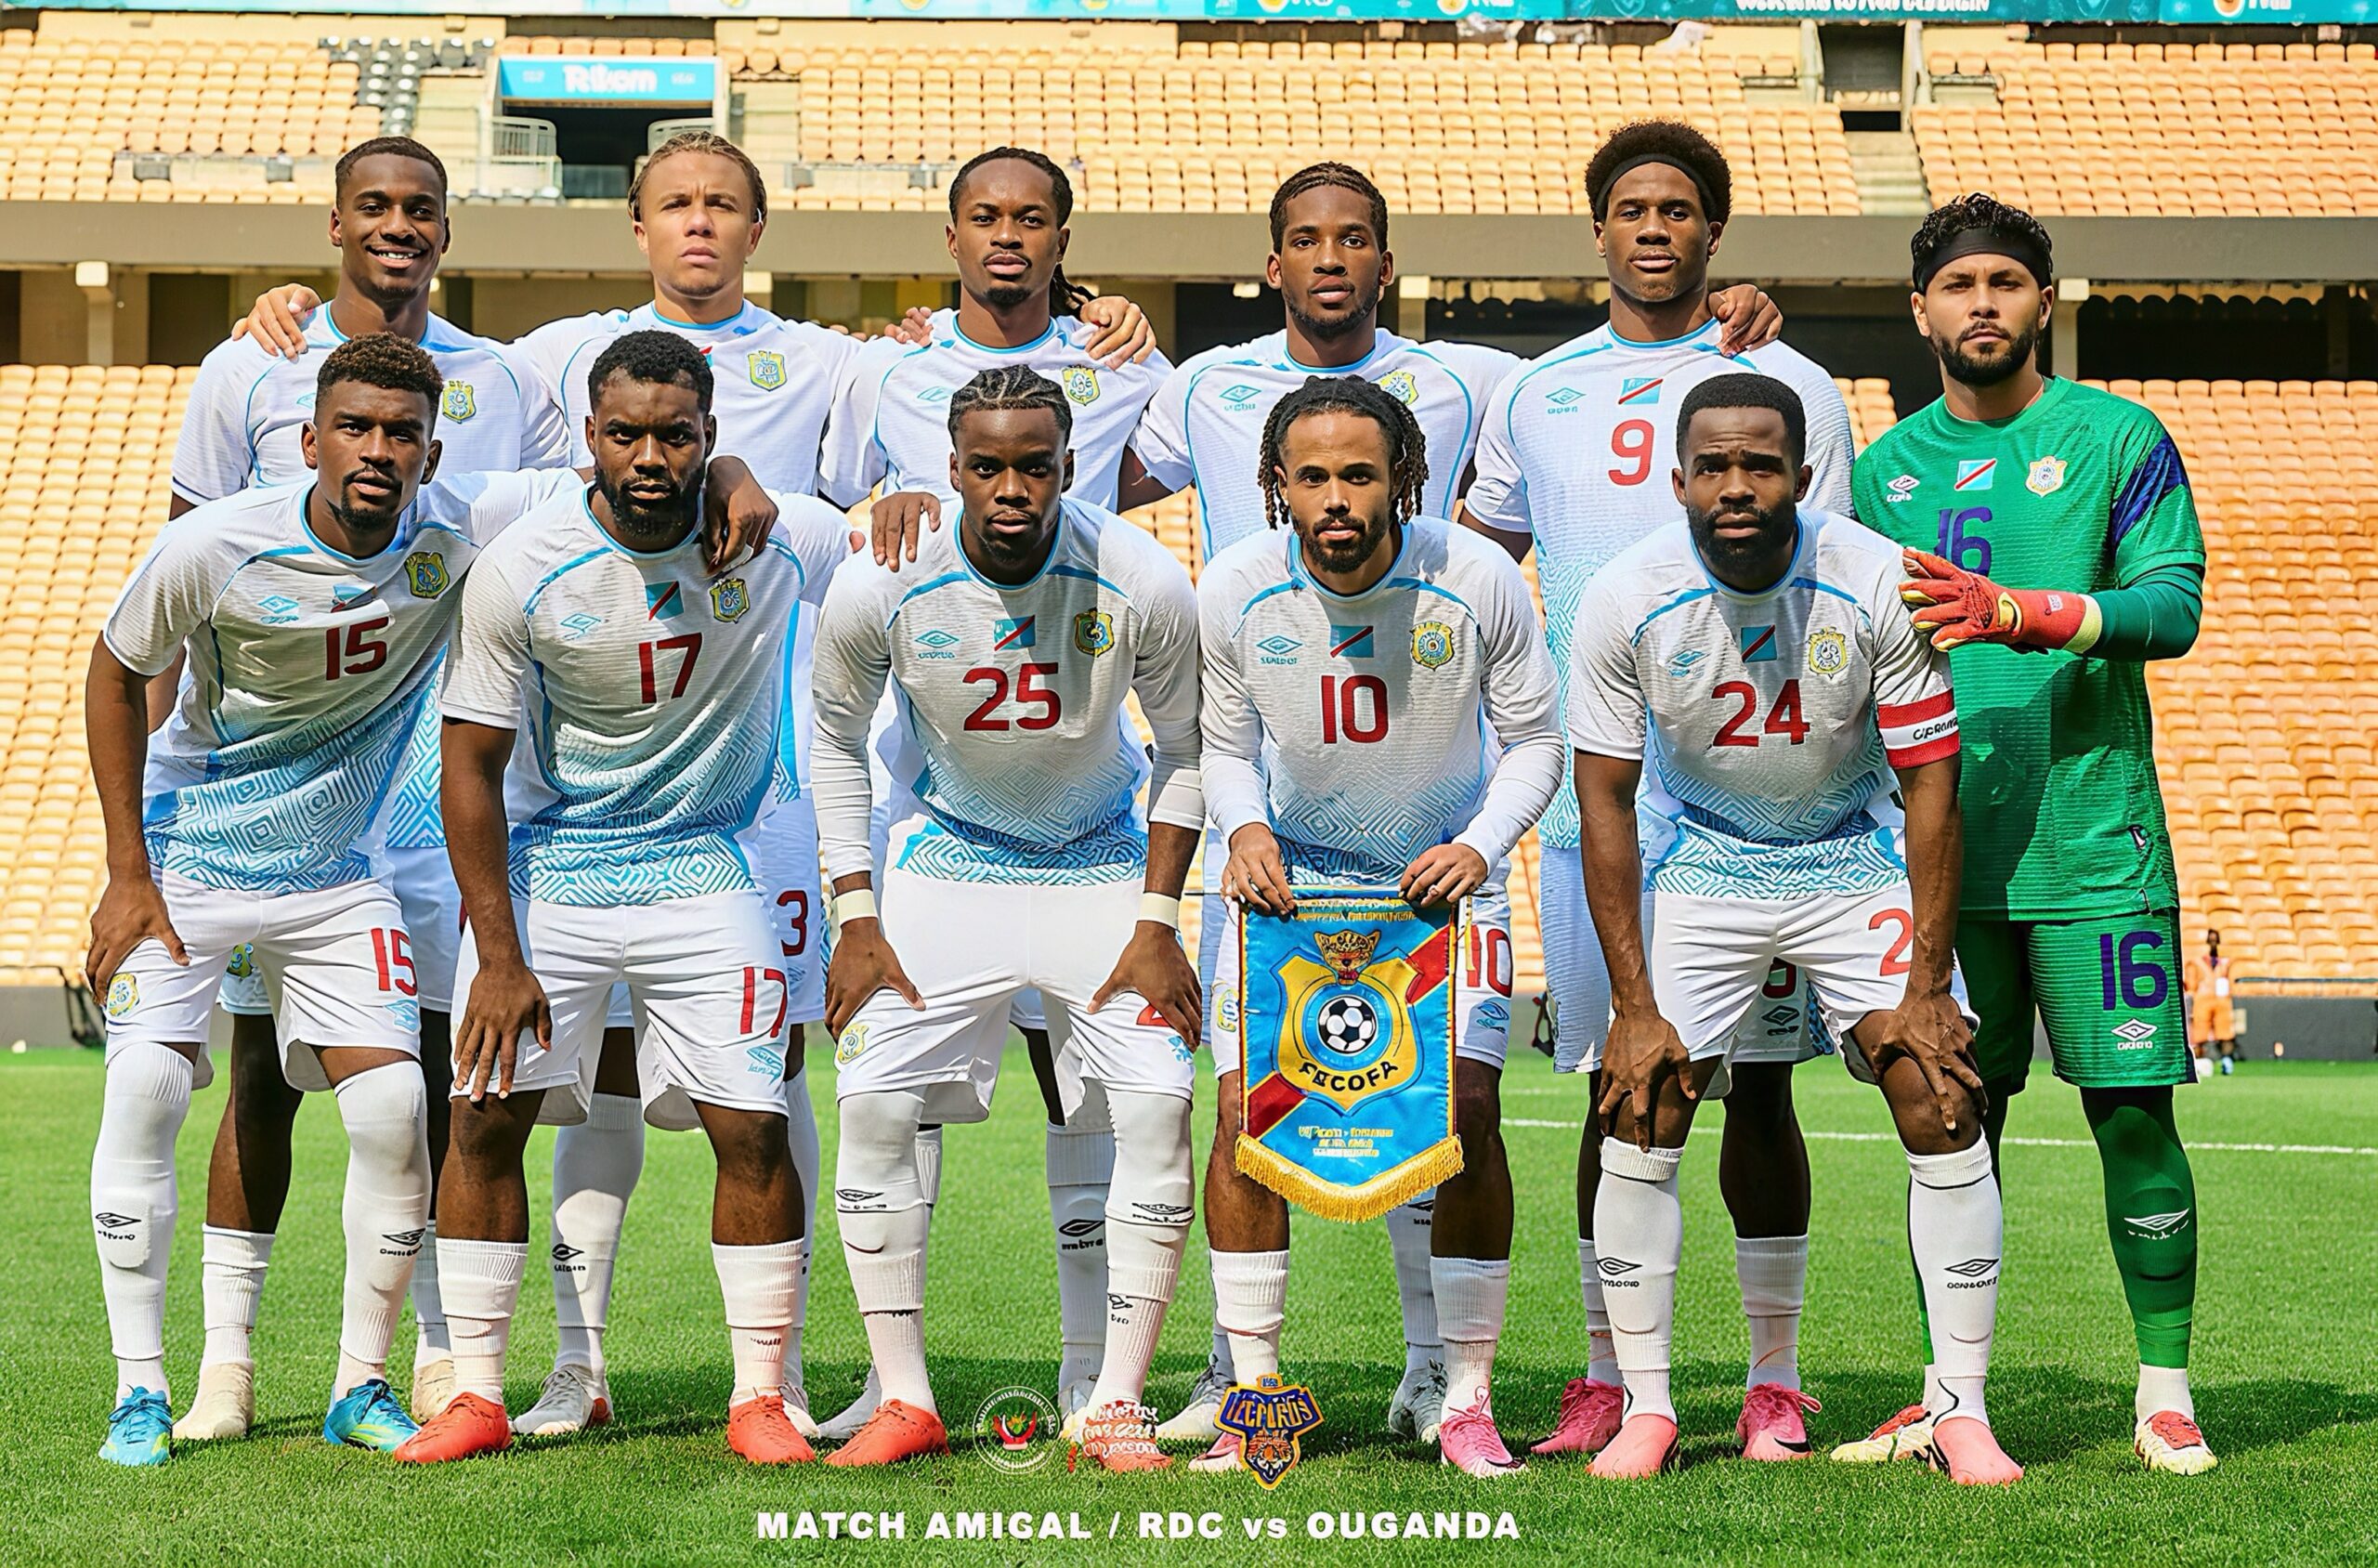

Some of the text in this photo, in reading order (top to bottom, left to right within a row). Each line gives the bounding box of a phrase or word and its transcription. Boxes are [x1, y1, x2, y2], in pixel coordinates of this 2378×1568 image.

[1608, 420, 1654, 486] 9
[1934, 506, 1993, 577] 16
[326, 617, 390, 681] 15
[639, 633, 702, 704] 17
[962, 662, 1062, 731] 25
[1321, 674, 1389, 744] 10
[1711, 679, 1810, 747] 24
[371, 928, 418, 996] 15
[1467, 924, 1513, 998] 10
[2100, 931, 2168, 1011] 16
[740, 967, 788, 1039] 17
